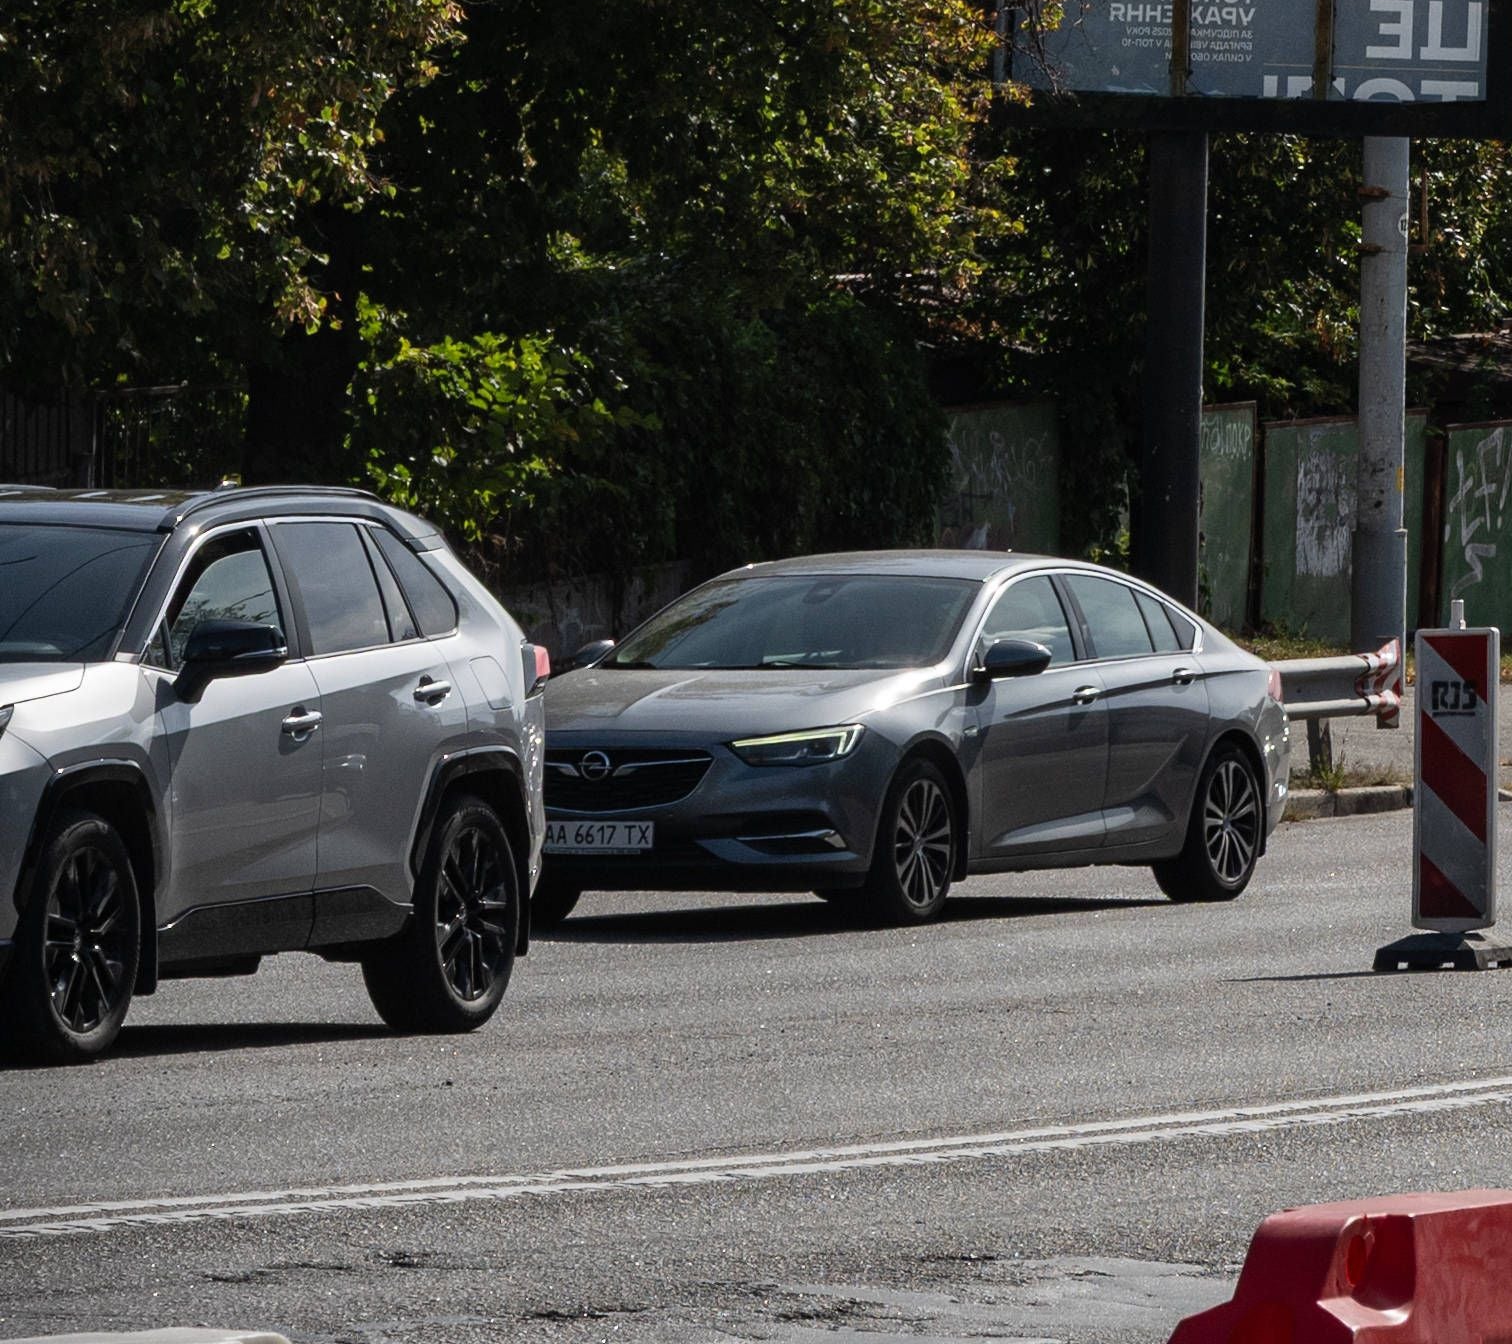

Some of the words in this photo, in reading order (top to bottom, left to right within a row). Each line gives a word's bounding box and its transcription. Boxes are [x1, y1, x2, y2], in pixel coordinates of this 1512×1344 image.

[546, 824, 567, 845] AA
[574, 824, 617, 845] 6617
[624, 824, 650, 845] TX
